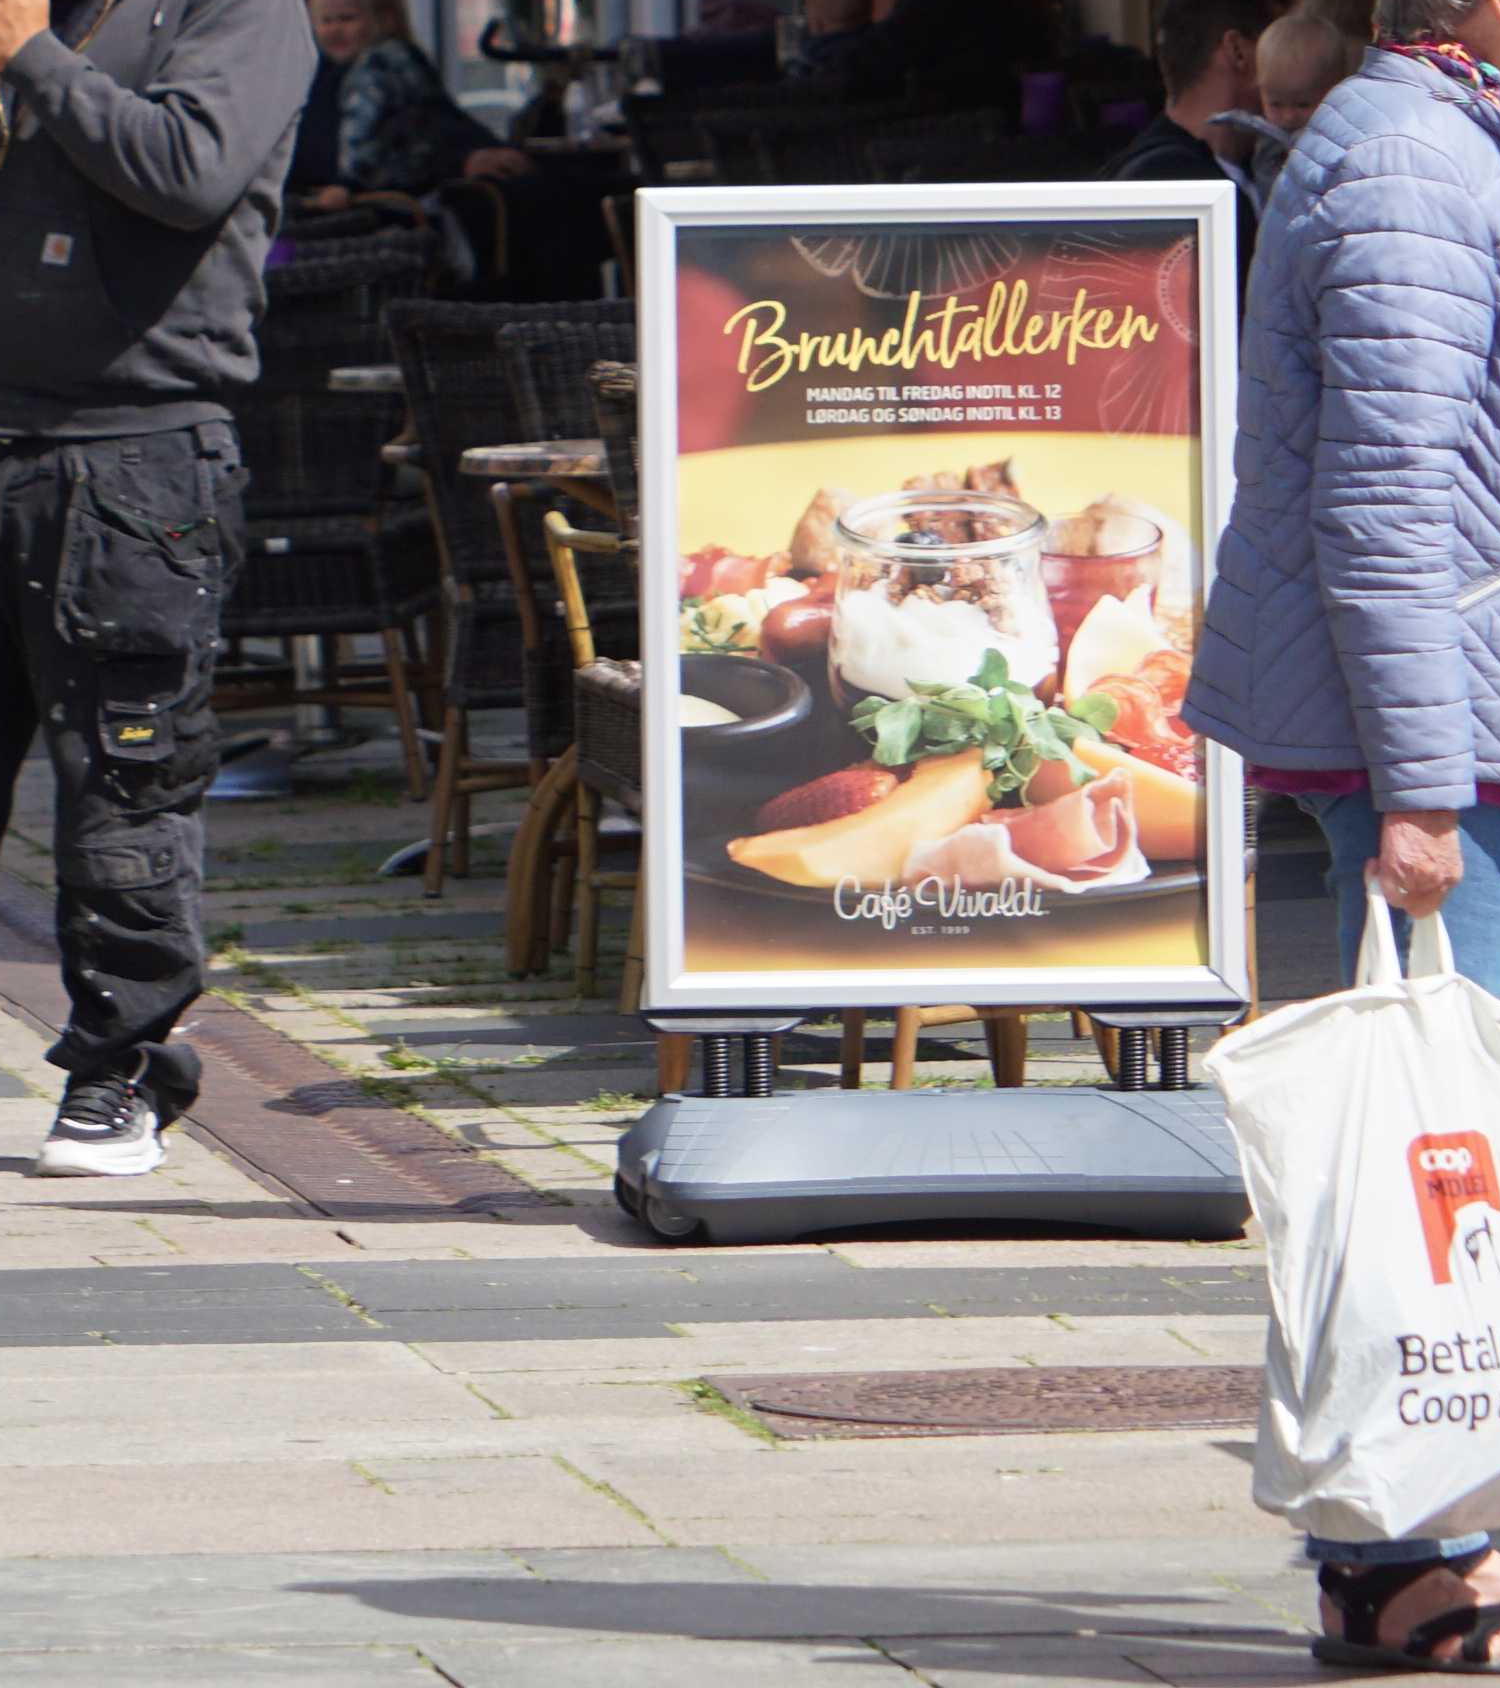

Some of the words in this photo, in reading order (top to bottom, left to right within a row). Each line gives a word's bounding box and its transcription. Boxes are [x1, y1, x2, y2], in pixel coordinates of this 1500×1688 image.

[724, 279, 1159, 392] Brunchtallerken
[806, 387, 875, 402] MANDAG
[876, 386, 900, 401] TIL
[902, 385, 963, 400] FREDAG
[966, 385, 1016, 400] INDTIL
[1044, 384, 1062, 399] 12
[806, 408, 870, 423] LØRDAG
[872, 408, 897, 422] OG
[898, 407, 964, 422] SØNDAG
[966, 406, 1016, 421] INDTIL
[1045, 406, 1062, 421] 13
[834, 874, 913, 930] Café
[914, 873, 1049, 918] Vivaldi
[1396, 1325, 1500, 1377] Betal
[1398, 1388, 1490, 1432] Coop
